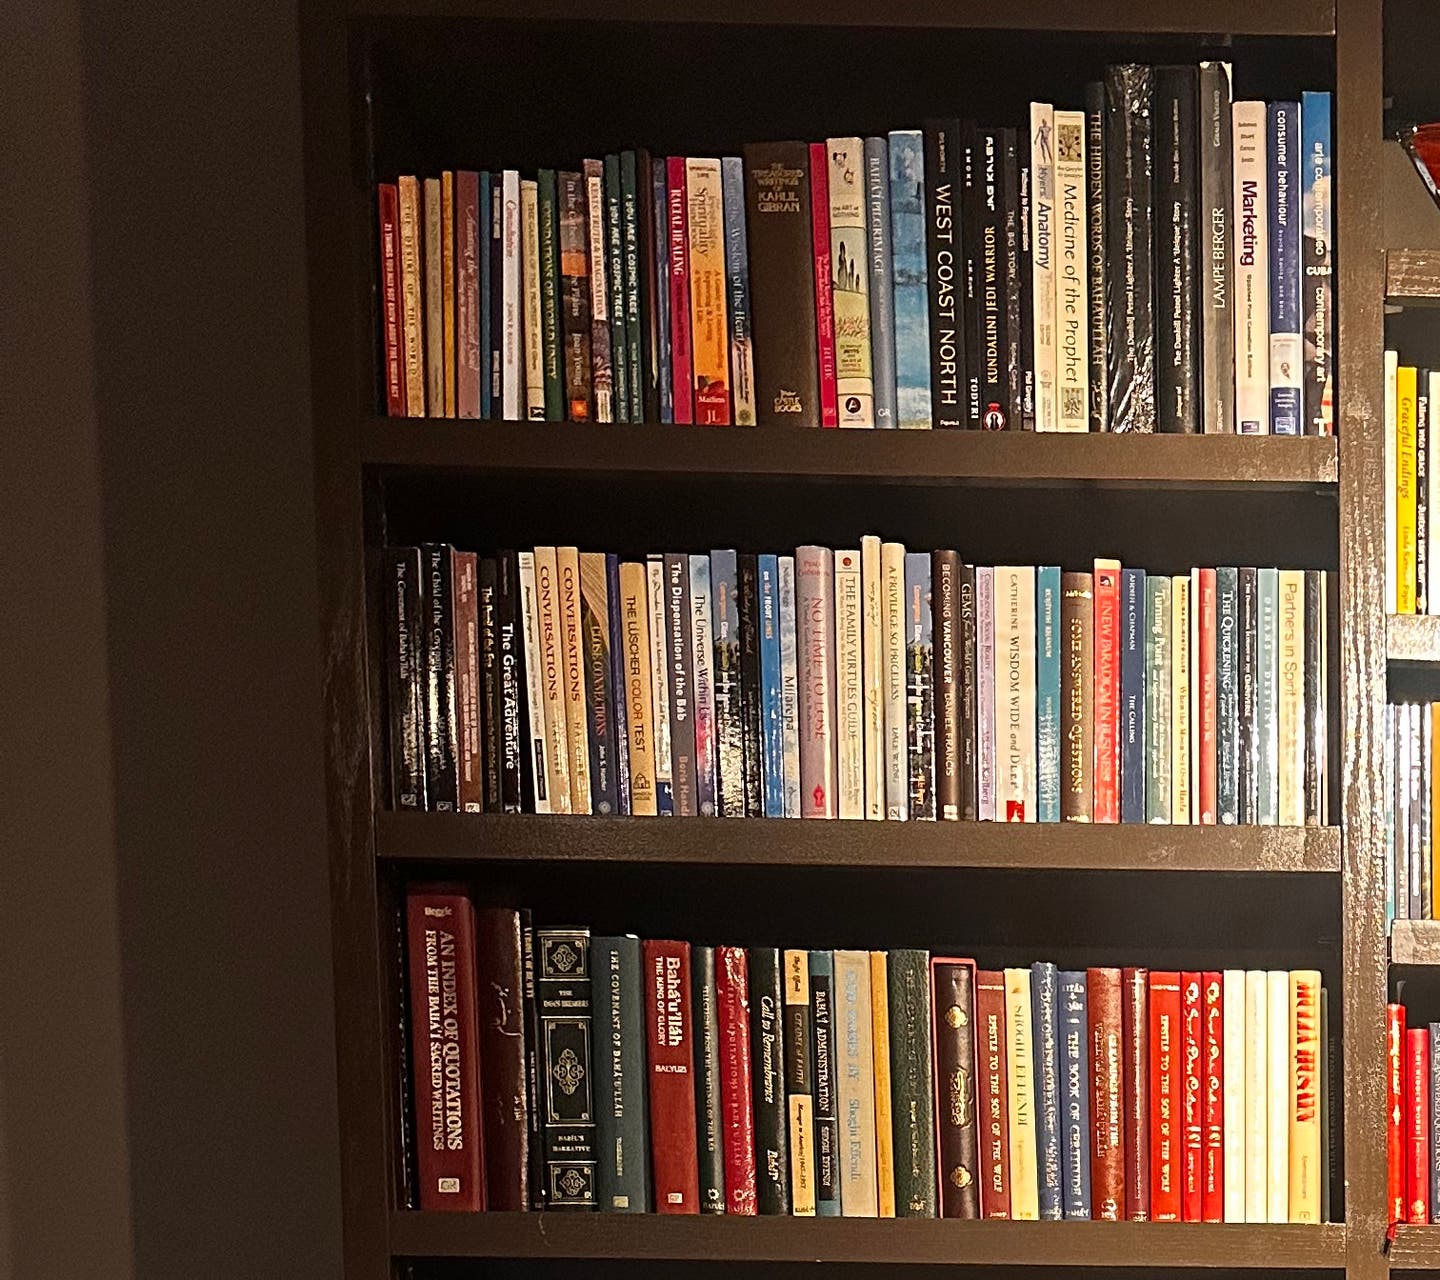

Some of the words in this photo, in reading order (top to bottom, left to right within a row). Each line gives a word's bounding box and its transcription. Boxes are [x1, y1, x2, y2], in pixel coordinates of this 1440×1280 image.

[1277, 110, 1289, 167] consumer
[1315, 142, 1325, 165] arte
[670, 189, 683, 226] RACIAL
[936, 185, 952, 241] WEST
[1278, 170, 1290, 225] behaviour
[1035, 202, 1051, 269] Anatomy
[1063, 184, 1079, 260] Medicine
[1239, 181, 1258, 266] Marketing
[672, 229, 684, 275] HEALING
[937, 251, 954, 319] COAST
[1065, 287, 1080, 314] the
[1313, 287, 1327, 363] contemporary
[939, 330, 956, 404] NORTH
[1062, 319, 1080, 382] Prophet
[1315, 367, 1326, 382] art
[671, 562, 683, 583] The
[503, 623, 514, 649] The
[541, 566, 559, 701] CONVERSATIONS
[563, 567, 581, 701] CONVERSATIONS
[670, 587, 684, 660] Dispensation
[1283, 583, 1297, 643] Partners
[504, 654, 515, 692] Great
[943, 621, 953, 683] VANCOUVER
[1285, 645, 1297, 658] in
[630, 679, 644, 720] COLOR
[675, 677, 686, 696] the
[1283, 662, 1298, 696] Spirit
[505, 697, 517, 769] Adventure
[945, 693, 954, 729] DANIEL
[1010, 696, 1020, 729] WIDE
[634, 724, 646, 752] TEST
[945, 733, 955, 775] FRANCIS
[441, 931, 456, 956] AN
[442, 960, 458, 1010] INDEX
[762, 996, 774, 1017] Call
[444, 1014, 459, 1039] OF
[763, 1020, 772, 1029] to
[762, 1032, 776, 1103] Remembrance
[445, 1042, 463, 1150] QUOTATIONS
